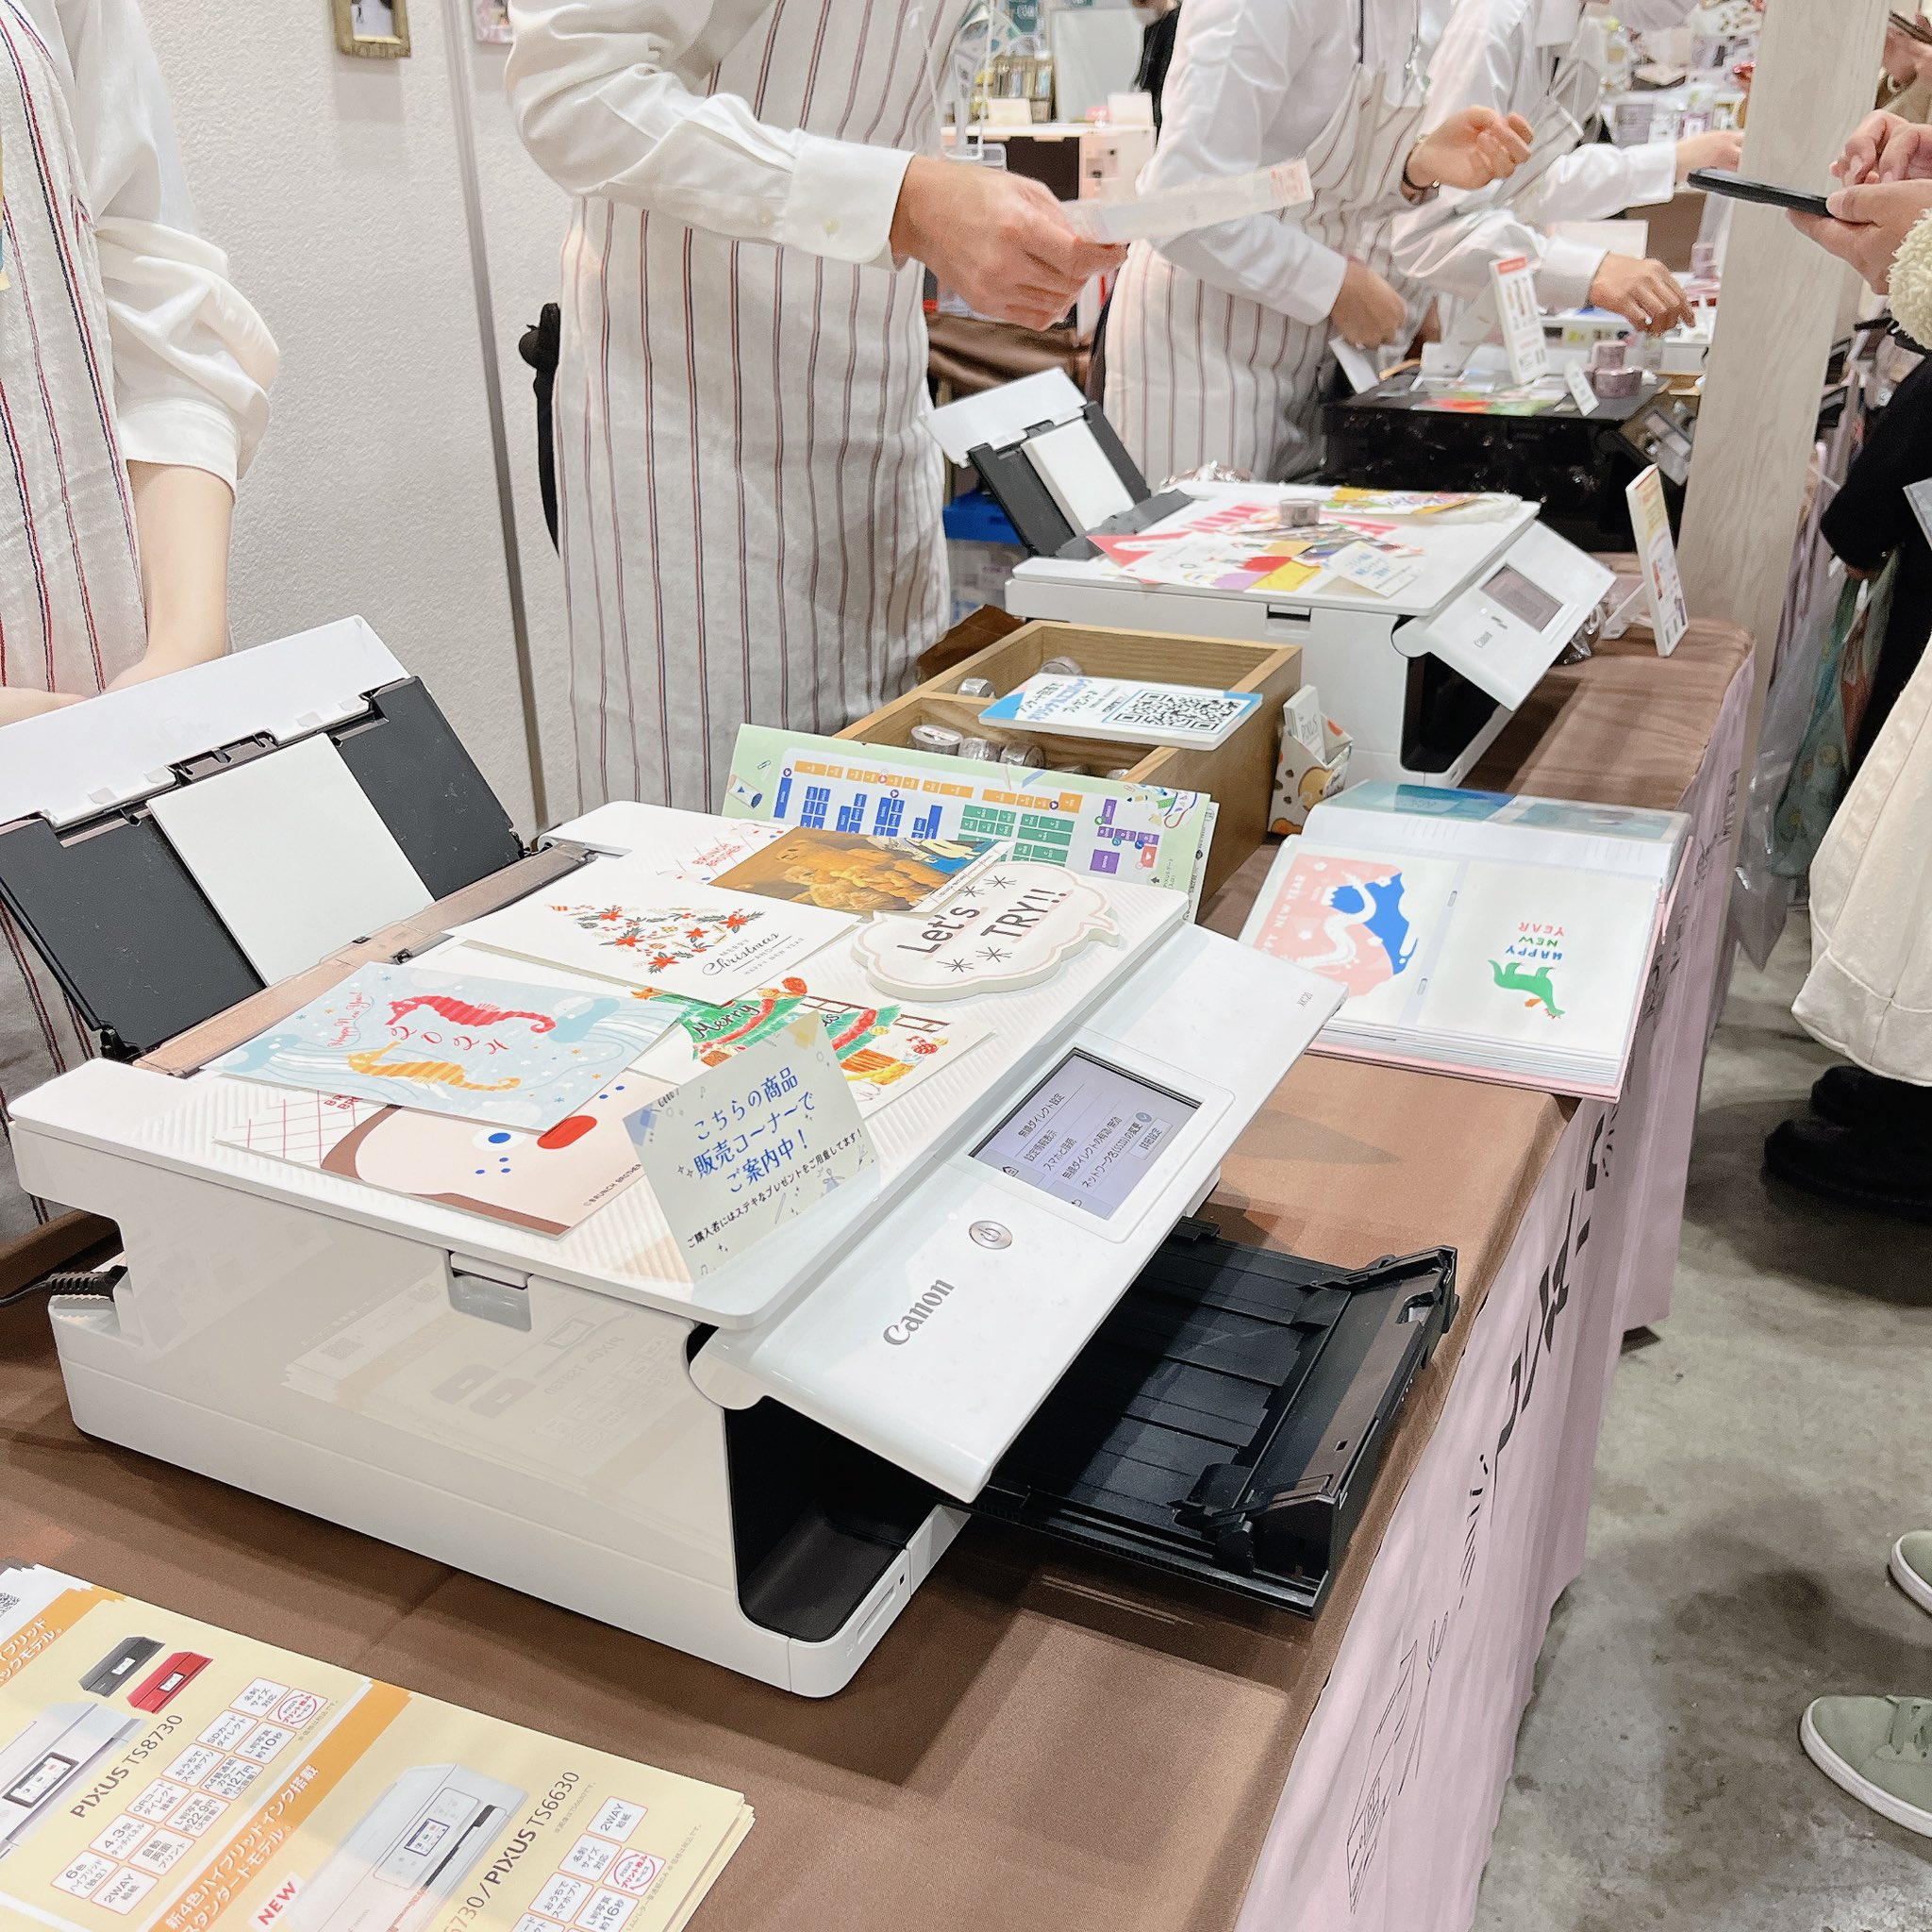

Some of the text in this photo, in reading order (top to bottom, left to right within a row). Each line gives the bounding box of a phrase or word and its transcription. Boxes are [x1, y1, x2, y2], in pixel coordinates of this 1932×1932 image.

[897, 907, 980, 954] Let's
[980, 888, 1067, 938] TRY!!
[1519, 922, 1564, 937] YEAR
[702, 932, 780, 975] Christmas
[1505, 945, 1563, 960] HAPPY
[1518, 936, 1558, 947] NEW
[691, 1004, 762, 1040] Merry
[694, 1066, 799, 1141] こちらの商品
[693, 1091, 816, 1179] 販売コーナーで
[883, 1279, 955, 1345] Canon
[208, 1715, 237, 1744] SDカード
[70, 1715, 183, 1818] PIXUS TS8730
[484, 1828, 537, 1885] PIXUS
[526, 1772, 580, 1826] TS6630
[600, 1803, 625, 1832] 2WAY
[165, 1764, 320, 1930] 新4色ハイブリッドインク搭載
[104, 1874, 134, 1904] 2WAY
[258, 1880, 297, 1926] NEW
[544, 1881, 569, 1911] おうちで
